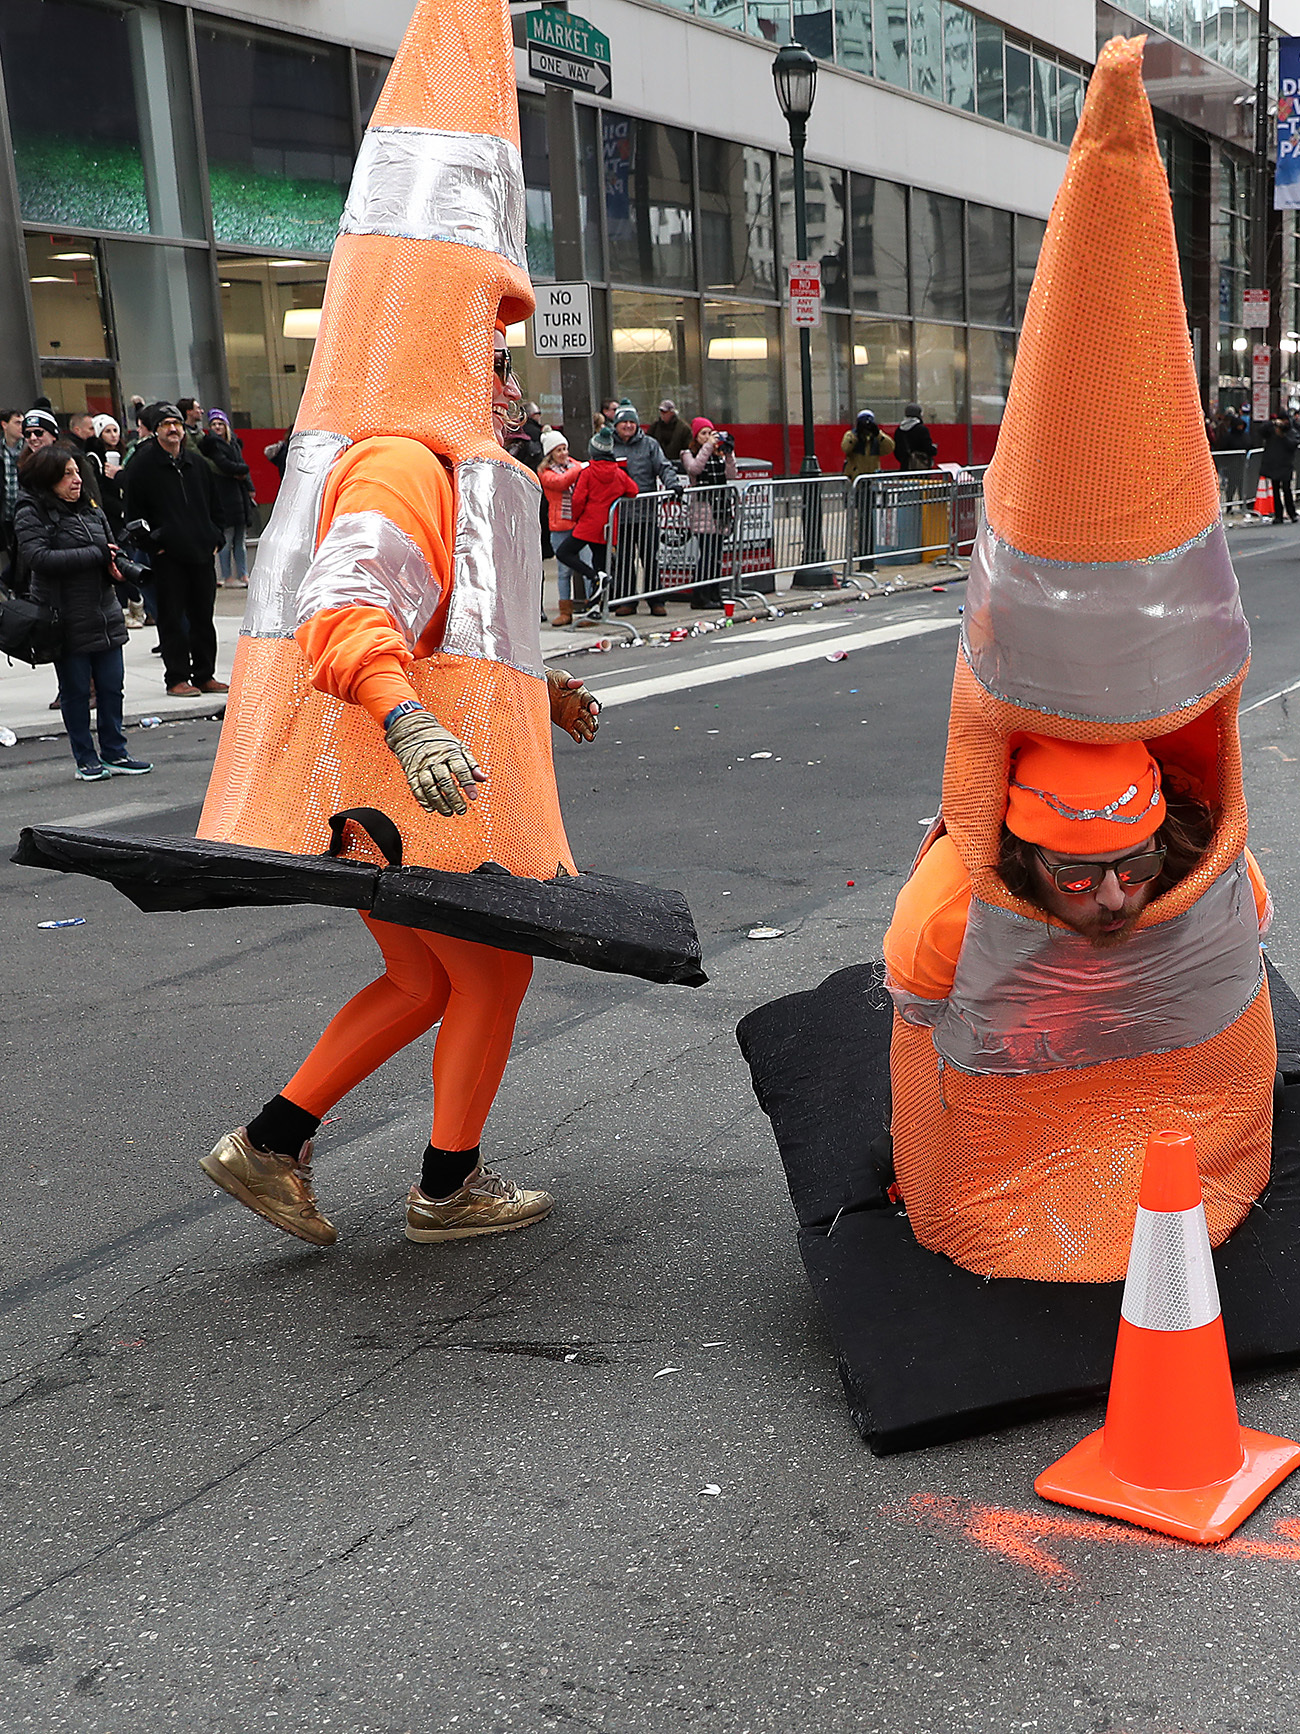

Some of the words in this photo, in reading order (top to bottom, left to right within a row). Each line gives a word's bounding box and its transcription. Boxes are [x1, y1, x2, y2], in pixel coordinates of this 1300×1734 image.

[533, 17, 588, 53] MARKET
[594, 42, 604, 57] ST
[540, 56, 561, 74] ONE
[567, 63, 590, 81] WAY
[799, 280, 811, 290] NO
[550, 291, 571, 305] NO
[796, 306, 813, 314] TIME
[543, 313, 581, 327] TURN
[540, 334, 558, 348] ON
[563, 333, 587, 347] RED
